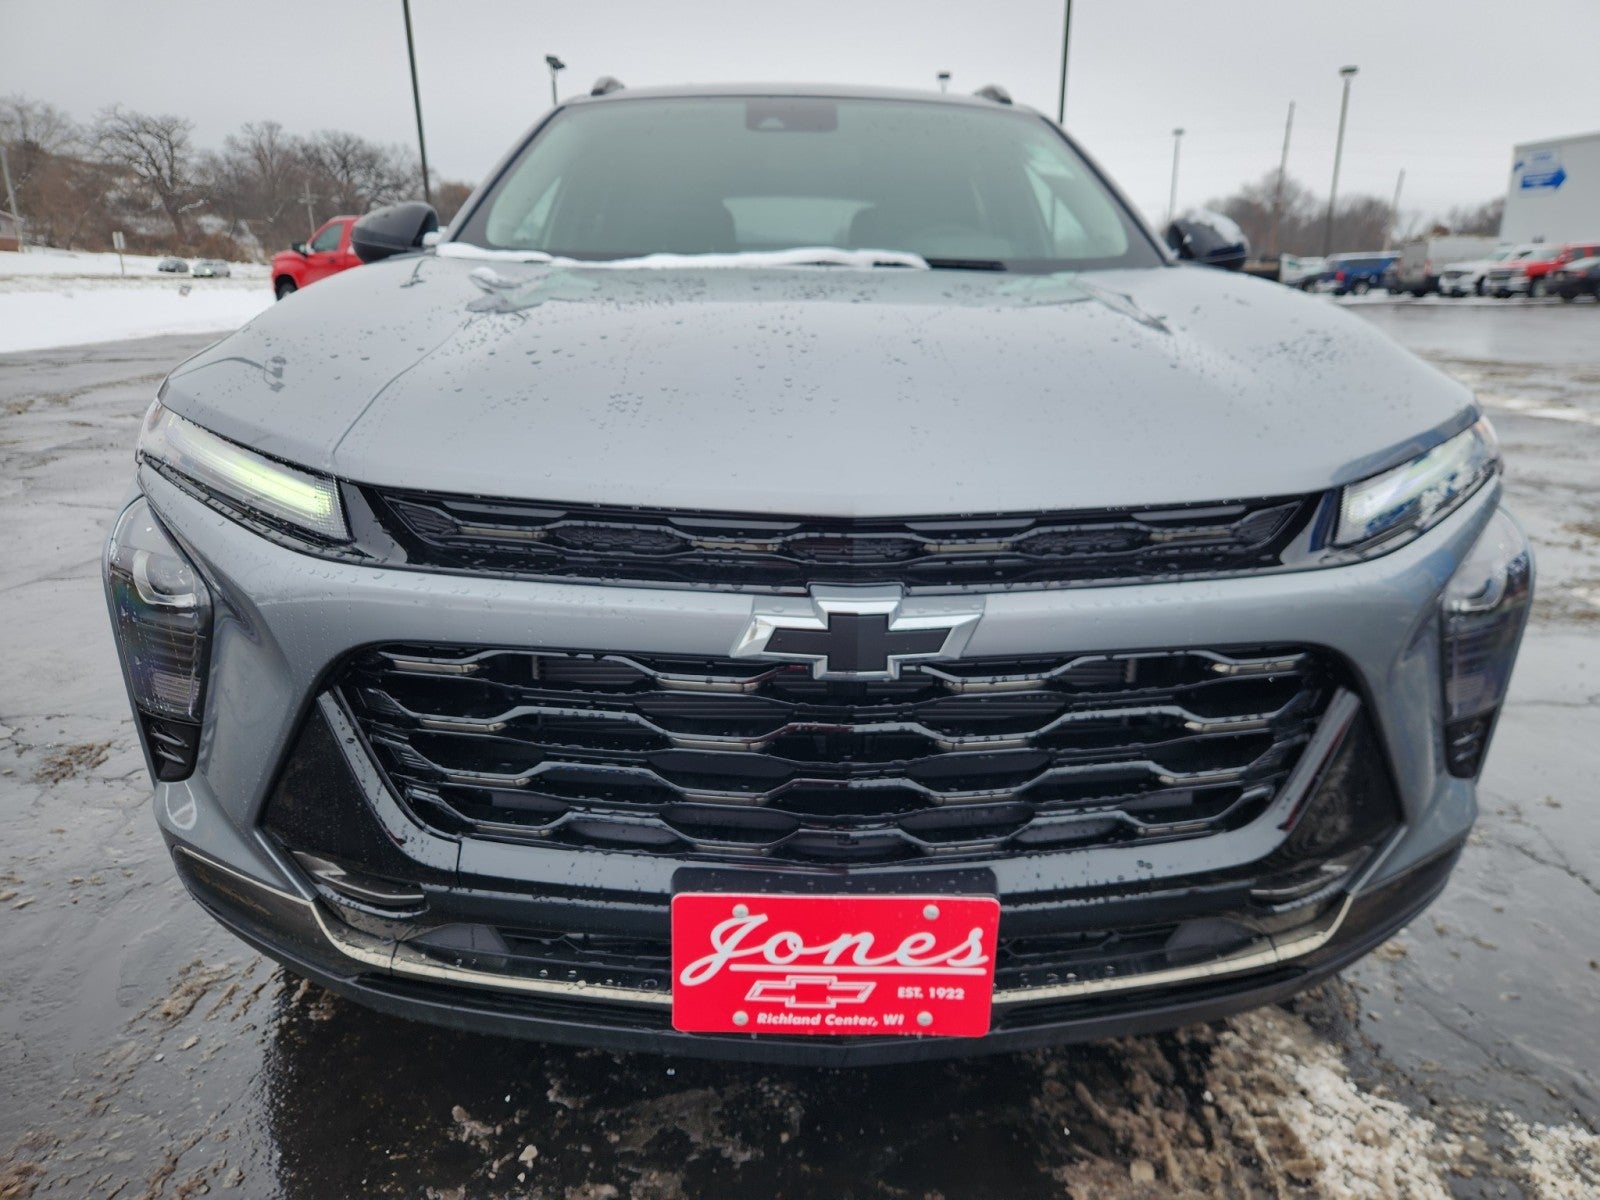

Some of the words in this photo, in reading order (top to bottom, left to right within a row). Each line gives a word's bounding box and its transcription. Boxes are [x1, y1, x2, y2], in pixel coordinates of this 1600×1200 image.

[679, 913, 989, 986] Jones
[897, 986, 924, 999] EST.
[929, 986, 965, 1000] 1922
[757, 1012, 820, 1026] Richland
[825, 1013, 879, 1027] Center,
[883, 1014, 904, 1026] WI
